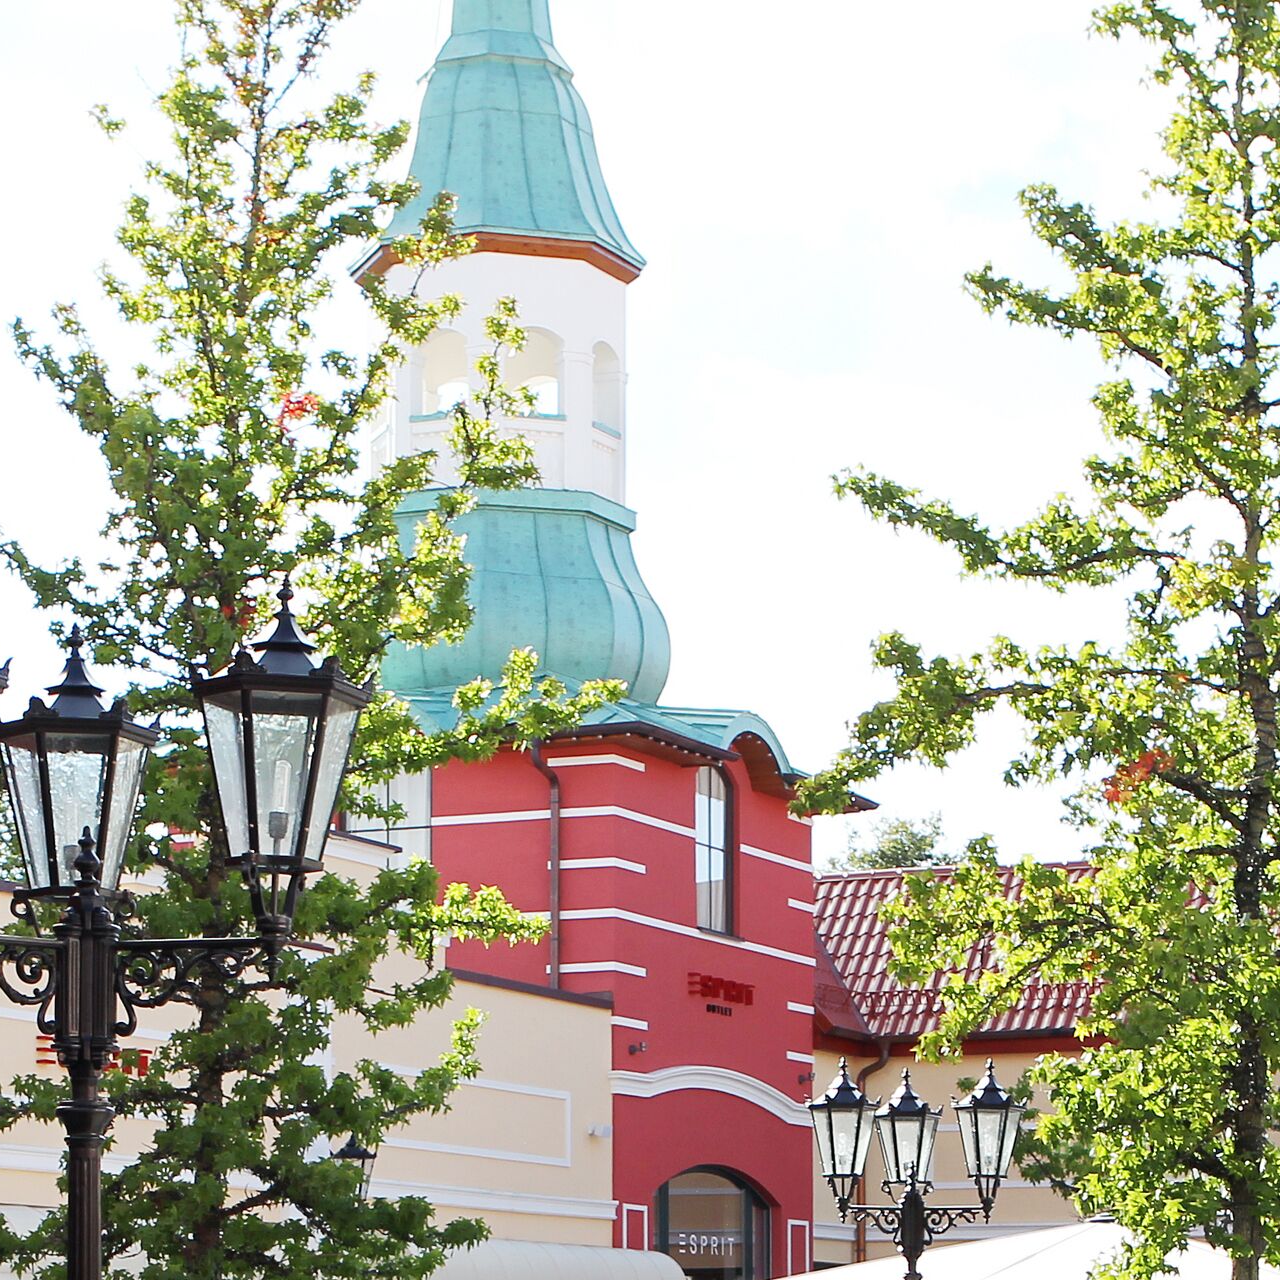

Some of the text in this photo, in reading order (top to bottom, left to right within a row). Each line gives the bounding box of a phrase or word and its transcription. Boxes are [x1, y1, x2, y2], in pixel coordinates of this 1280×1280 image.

[687, 972, 755, 1006] ESPRIT
[706, 1004, 732, 1016] OUTLET
[679, 1233, 735, 1257] ESPRIT
